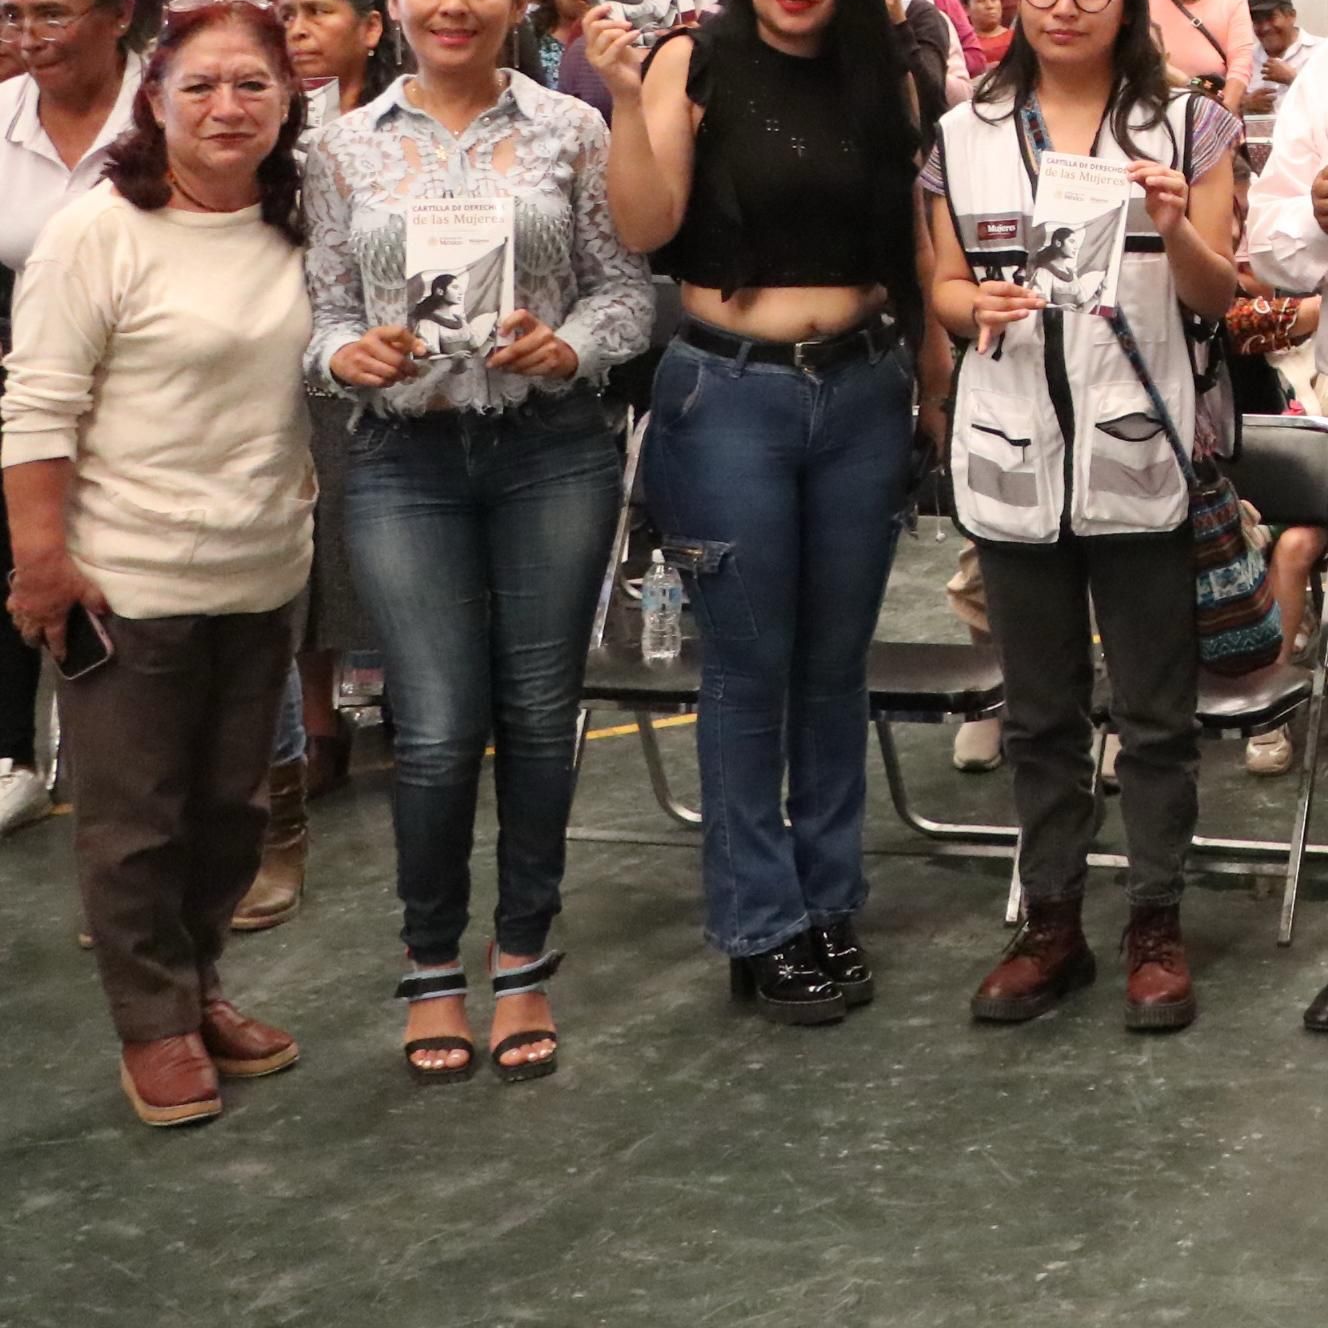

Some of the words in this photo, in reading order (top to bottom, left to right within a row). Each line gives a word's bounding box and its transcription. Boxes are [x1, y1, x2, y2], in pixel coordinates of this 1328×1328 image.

[1046, 157, 1078, 169] CARTILLA
[1079, 162, 1089, 170] DE
[1045, 166, 1058, 177] de
[1060, 168, 1076, 180] las
[1079, 170, 1125, 187] Mujeres
[412, 204, 450, 212] CARTILLA
[412, 215, 427, 225] de
[432, 214, 449, 225] las
[454, 213, 505, 226] Mujeres
[987, 224, 1017, 233] Mujeres
